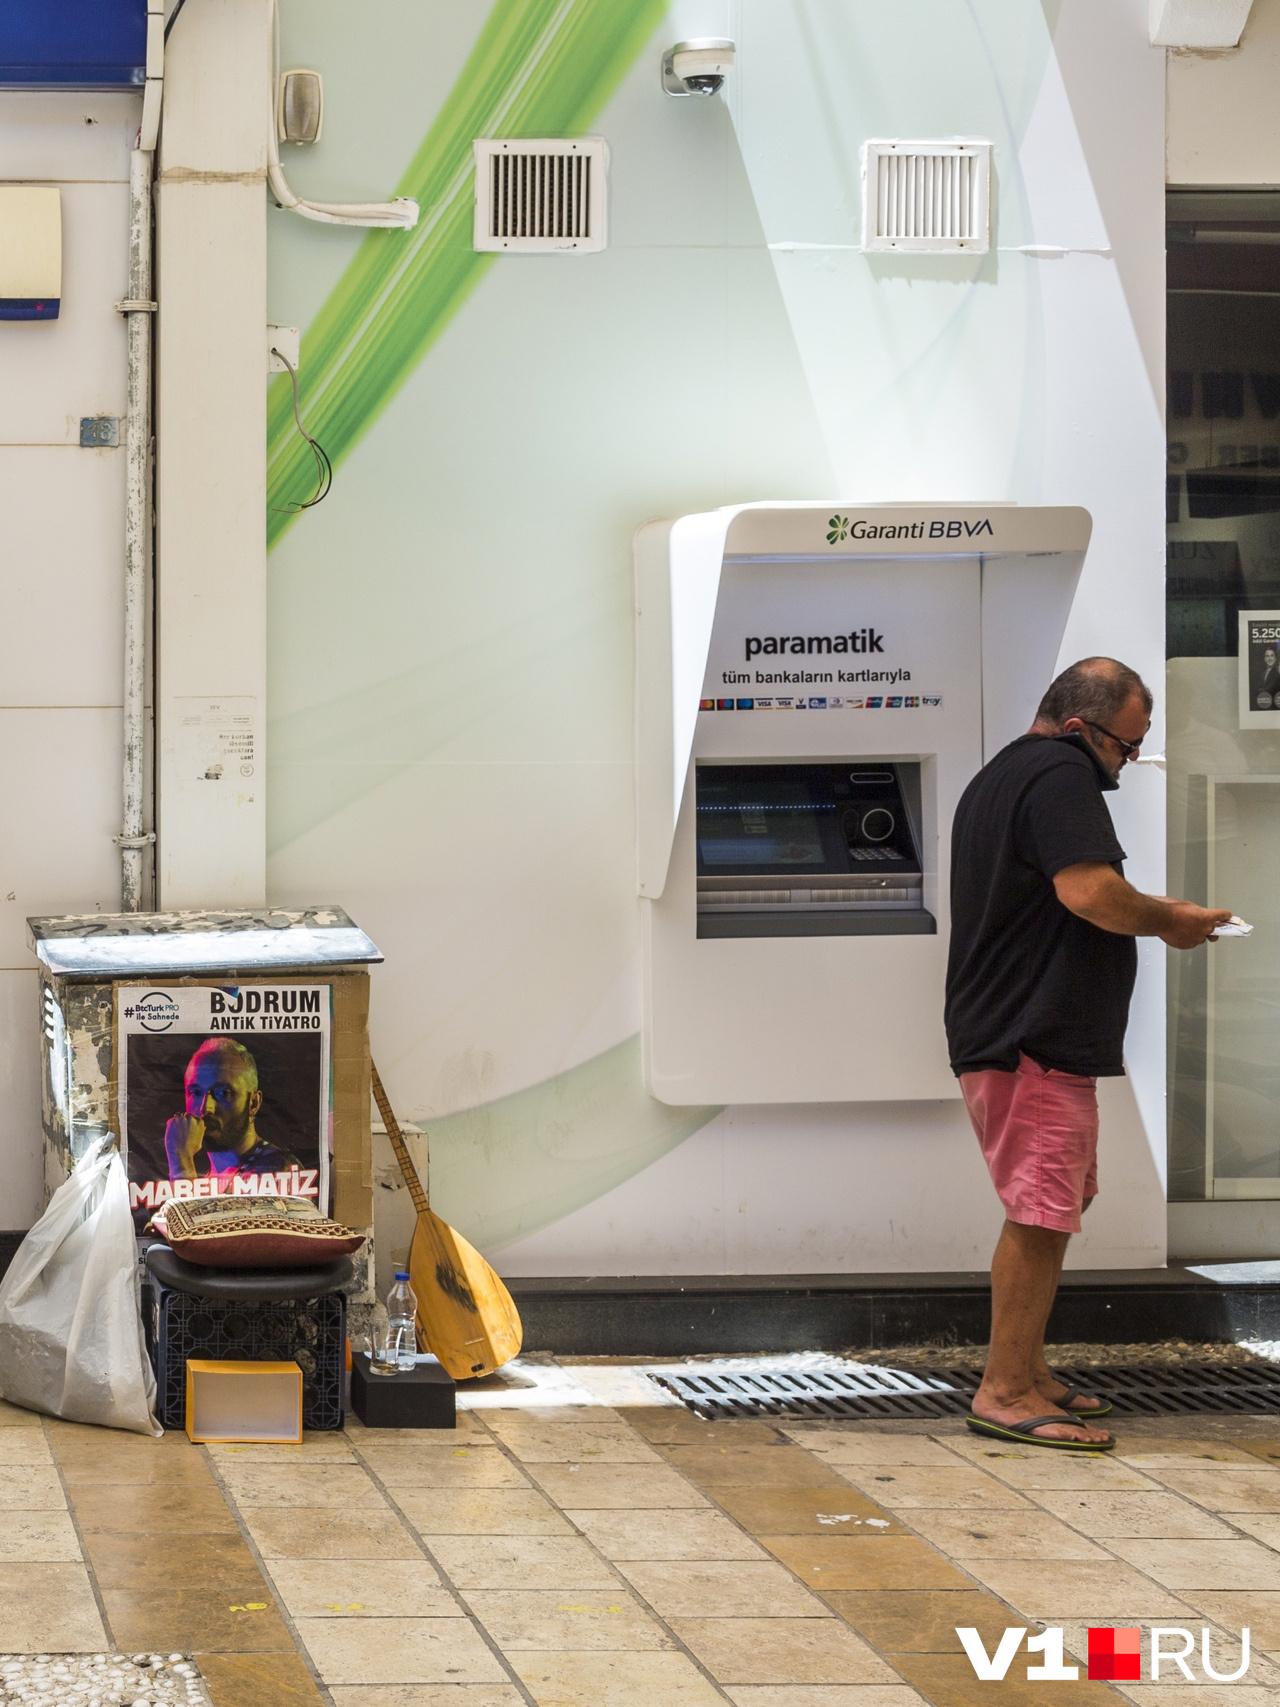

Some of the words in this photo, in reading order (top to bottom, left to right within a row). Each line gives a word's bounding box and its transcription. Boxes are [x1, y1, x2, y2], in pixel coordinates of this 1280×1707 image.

[850, 520, 925, 539] Garanti
[928, 518, 994, 538] BBVA
[744, 628, 885, 661] paramatik
[722, 671, 751, 684] tüm
[755, 670, 833, 684] bankaların
[837, 668, 911, 685] kartlarıyla
[922, 697, 940, 706] troy
[135, 1004, 164, 1012] BtcTurk
[165, 1004, 179, 1012] PRO
[130, 1177, 219, 1208] MABEL
